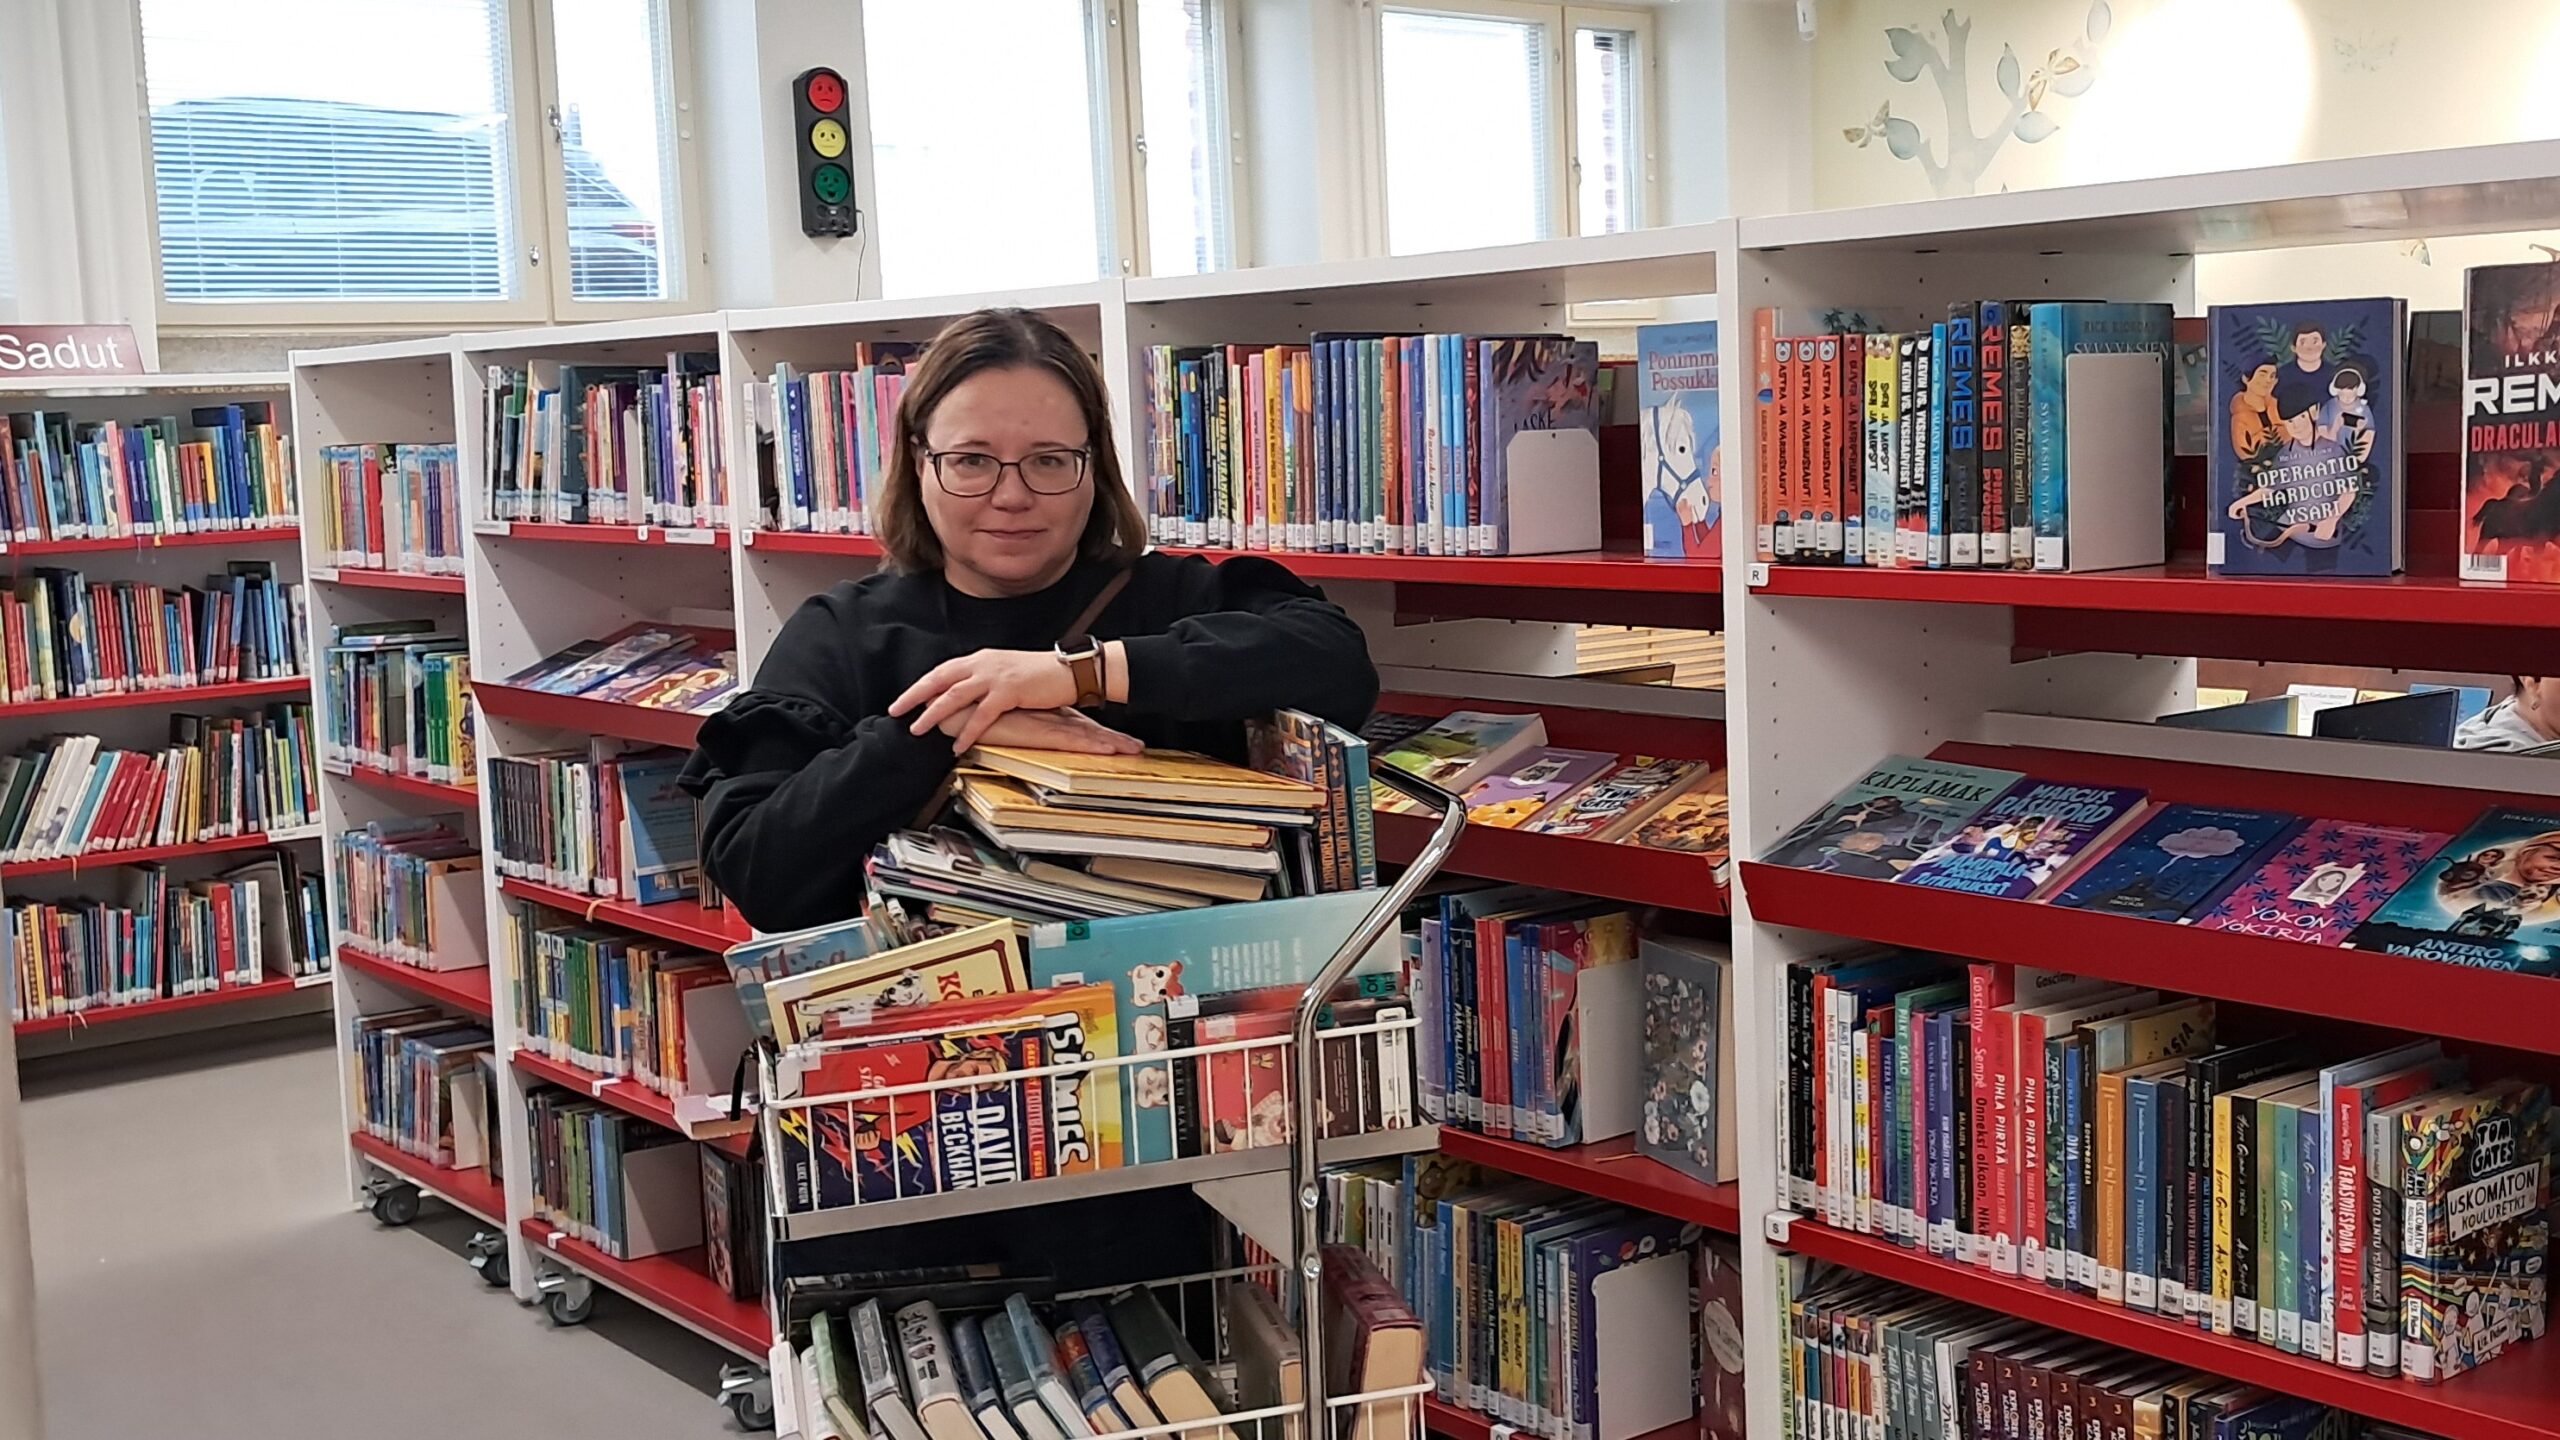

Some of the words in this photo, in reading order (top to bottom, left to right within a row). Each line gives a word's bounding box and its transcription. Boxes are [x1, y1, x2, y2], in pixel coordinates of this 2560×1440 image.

[0, 335, 124, 370] Sadut
[1649, 350, 1718, 371] Ponimm
[2504, 350, 2560, 368] ILKK
[1651, 367, 1718, 391] Possukk
[1901, 361, 1912, 393] KEVIN
[1917, 356, 1929, 389] KEVIN
[1951, 317, 1974, 450] REMES
[1981, 324, 2004, 451] REMES
[2465, 373, 2560, 416] REM
[1900, 414, 1911, 489] YKSISARVISET
[1914, 410, 1927, 486] YKSISARVISET
[2471, 424, 2560, 452] DRACULA
[2257, 455, 2359, 488] OPERAATIO
[2262, 475, 2360, 508] HARDCORE
[2286, 501, 2341, 525] YSARI
[1751, 569, 1760, 582] R
[1860, 771, 1993, 802] KAPLAMAK
[2031, 784, 2117, 804] MARCUS
[1355, 785, 1374, 868] USKOMATON
[1991, 797, 2115, 825] RASHFORD
[2246, 905, 2336, 929] YOKON
[2384, 943, 2521, 972] VAROVAINEN
[2415, 938, 2504, 958] ANTERO
[1972, 975, 1987, 1033] Goscinny
[1171, 1027, 1187, 1096] TAEREH
[1898, 1044, 1909, 1076] SALO
[1973, 1047, 1988, 1089] Sempé
[858, 1066, 875, 1104] STAS
[1994, 1073, 2005, 1110] PIHLA
[2025, 1076, 2036, 1114] PIHLA
[1027, 1088, 1046, 1147] FOOTBALL
[1974, 1097, 1989, 1150] Onneksi
[2476, 1118, 2512, 1143] TOM
[966, 1105, 1016, 1187] DAVID
[1994, 1114, 2008, 1164] PIIRTÄÄ
[2025, 1118, 2038, 1168] PIIRTÄÄ
[2471, 1139, 2514, 1176] GATES
[2338, 1164, 2356, 1254] TERÄSMIESPOIKA
[2372, 1187, 2381, 1215] OUTO
[2449, 1170, 2535, 1216] USKOMATON
[1772, 1223, 1779, 1235] S
[1977, 1206, 1991, 1235] Nikk
[2372, 1216, 2382, 1248] LINTU
[2415, 1201, 2426, 1255] USKOMATON
[1975, 1360, 1985, 1371] 2
[2004, 1367, 2013, 1378] 2
[2030, 1376, 2039, 1387] 2
[2060, 1382, 2069, 1393] 3
[2089, 1396, 2097, 1407] 3
[1980, 1382, 1992, 1431] EXPLORER
[2007, 1389, 2019, 1438] EXPLORER
[2034, 1398, 2045, 1440] EXPLORE
[2113, 1403, 2122, 1415] 3
